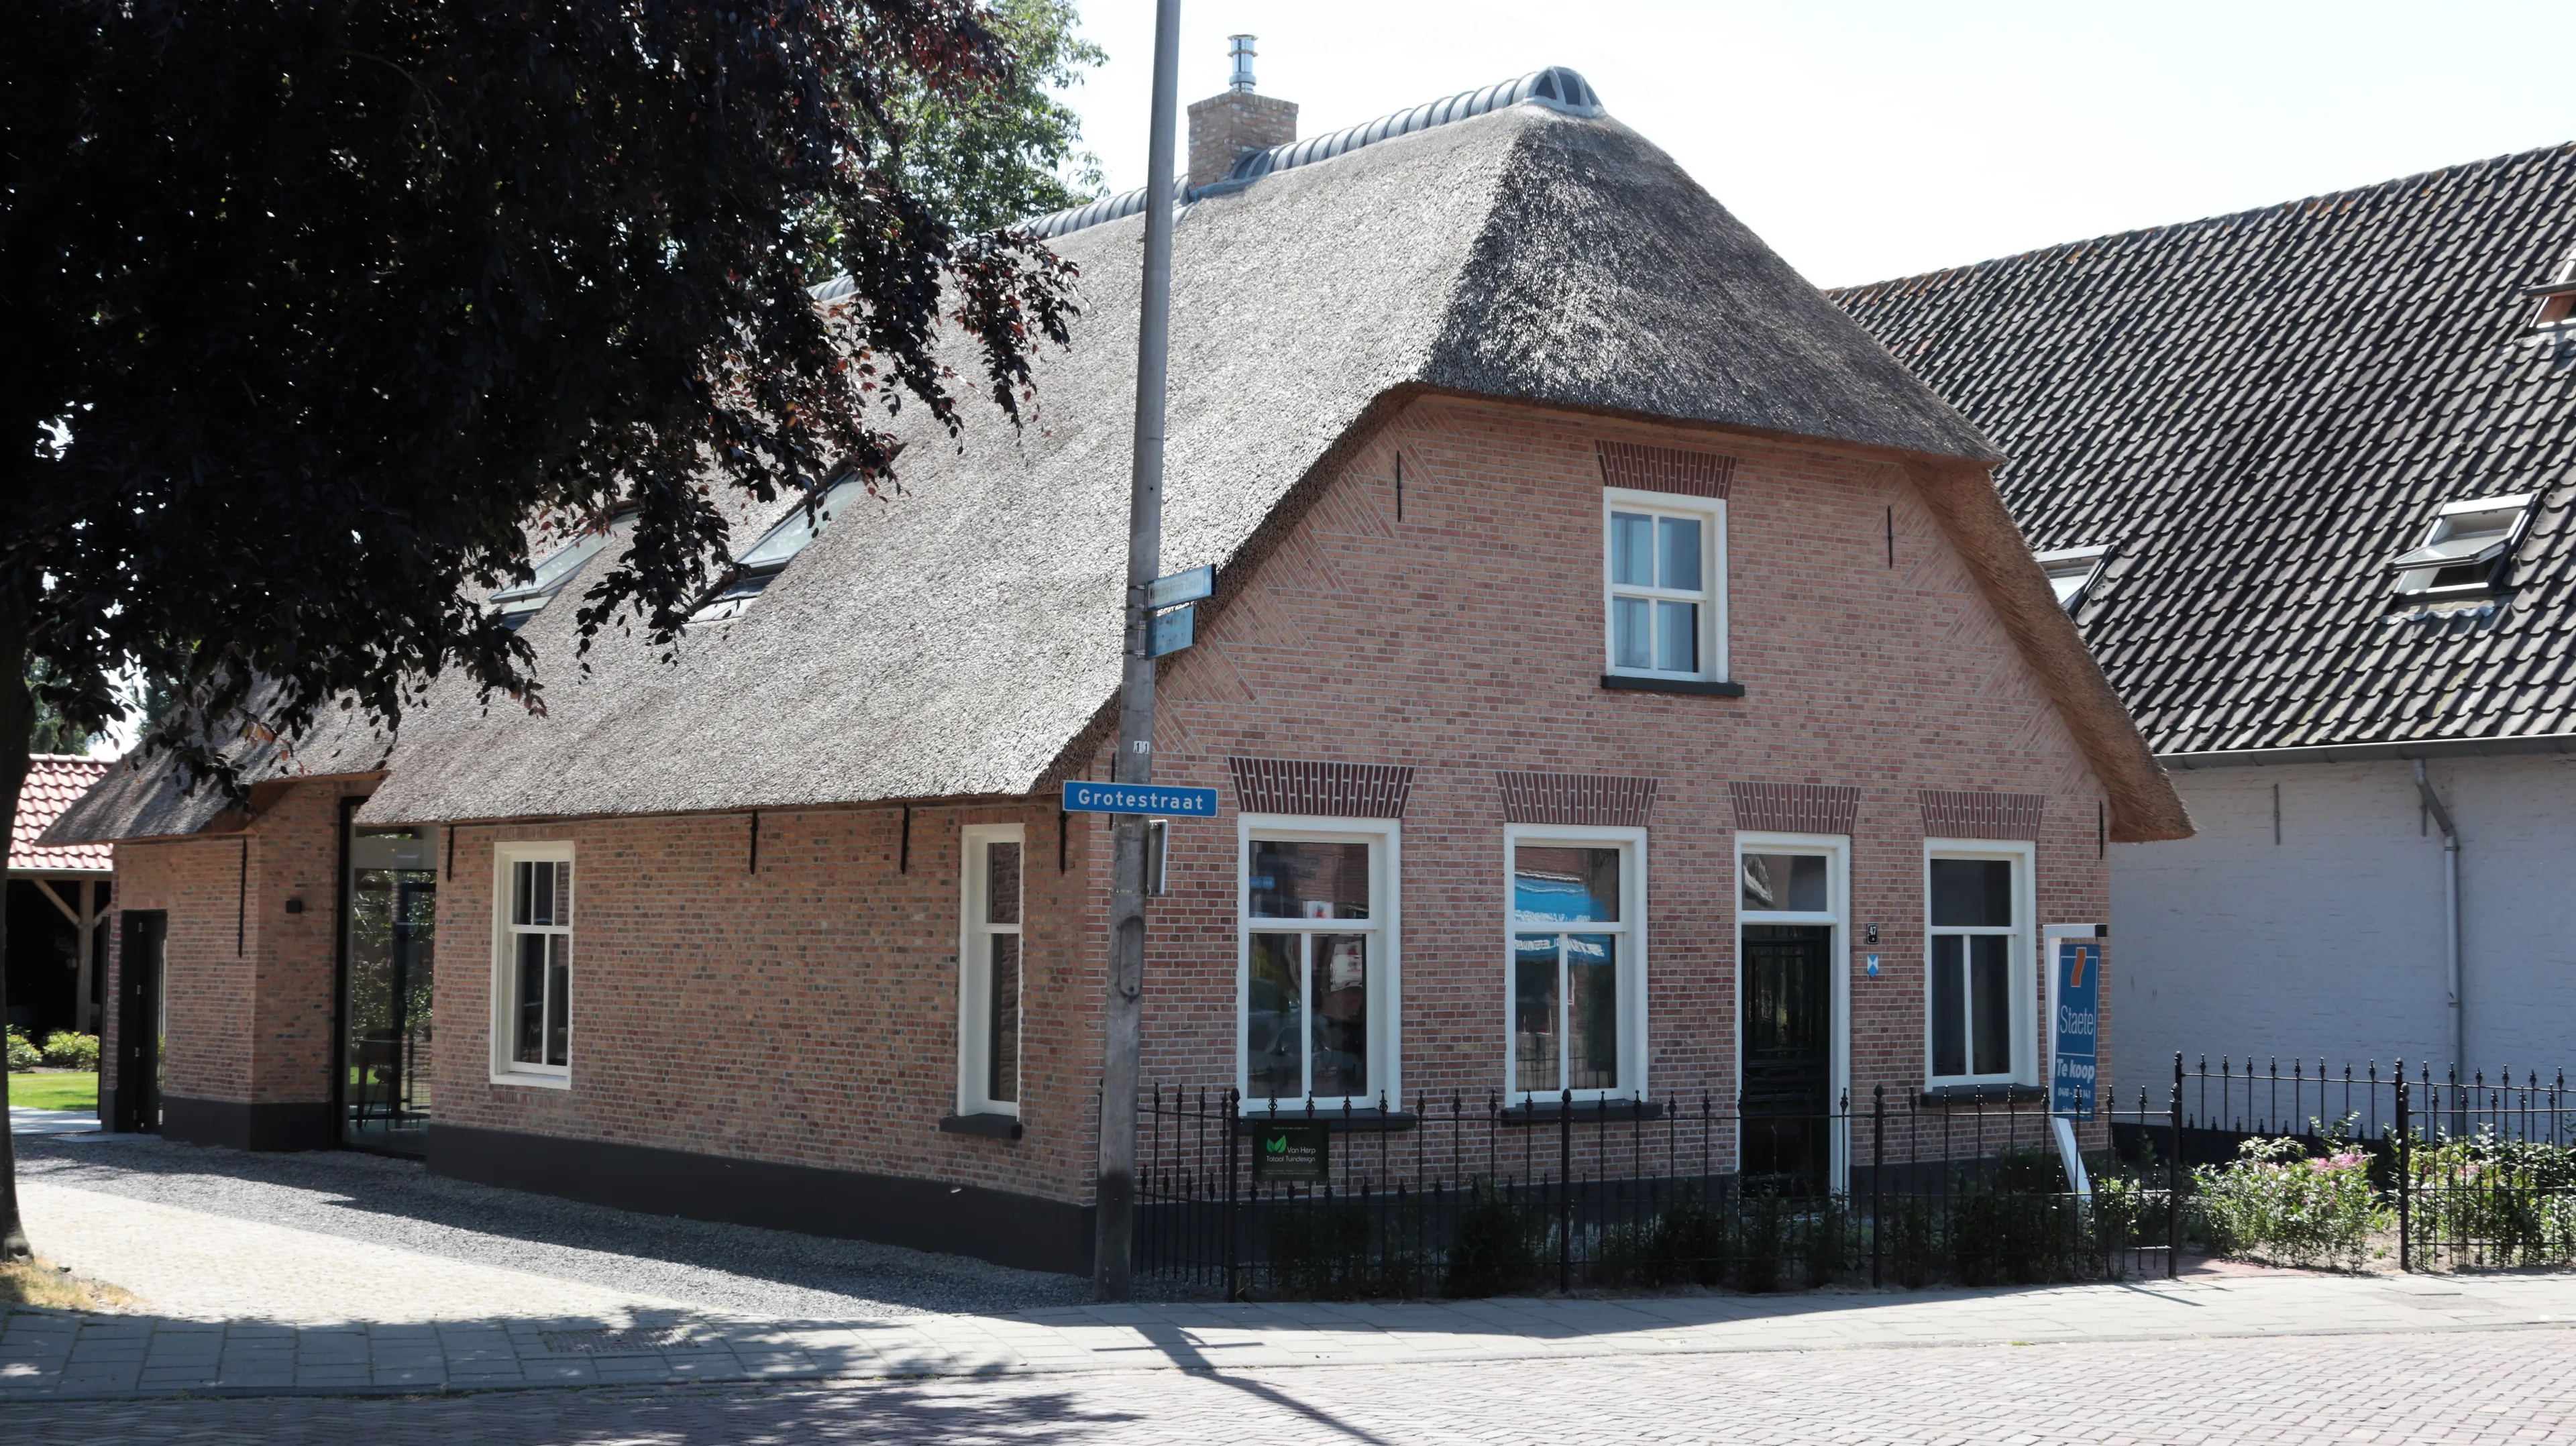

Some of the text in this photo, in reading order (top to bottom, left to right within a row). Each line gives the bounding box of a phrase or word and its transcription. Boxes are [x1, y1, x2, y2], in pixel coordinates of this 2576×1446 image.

[1078, 789, 1203, 810] Grotestraat
[1869, 926, 1876, 936] 47
[2059, 1005, 2094, 1036] Staete
[2056, 1058, 2095, 1084] Te koop
[1300, 1146, 1316, 1155] Herp
[1285, 1156, 1316, 1164] Tuindesign
